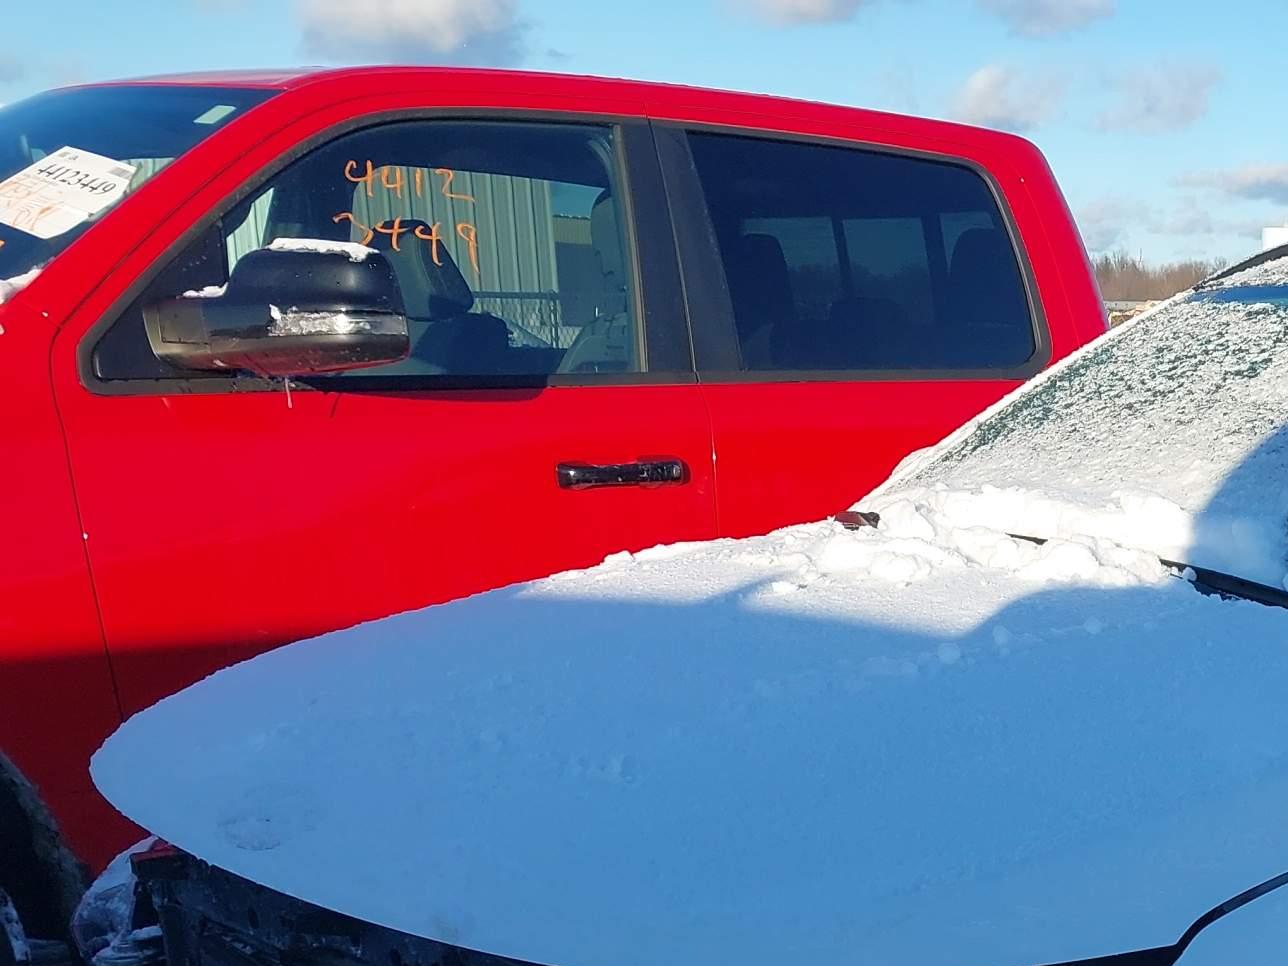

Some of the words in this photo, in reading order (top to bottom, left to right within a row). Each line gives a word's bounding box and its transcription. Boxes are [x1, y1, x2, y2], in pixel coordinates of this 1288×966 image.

[37, 163, 117, 195] 44123449
[344, 160, 475, 202] 4412
[332, 212, 480, 274] 3449
